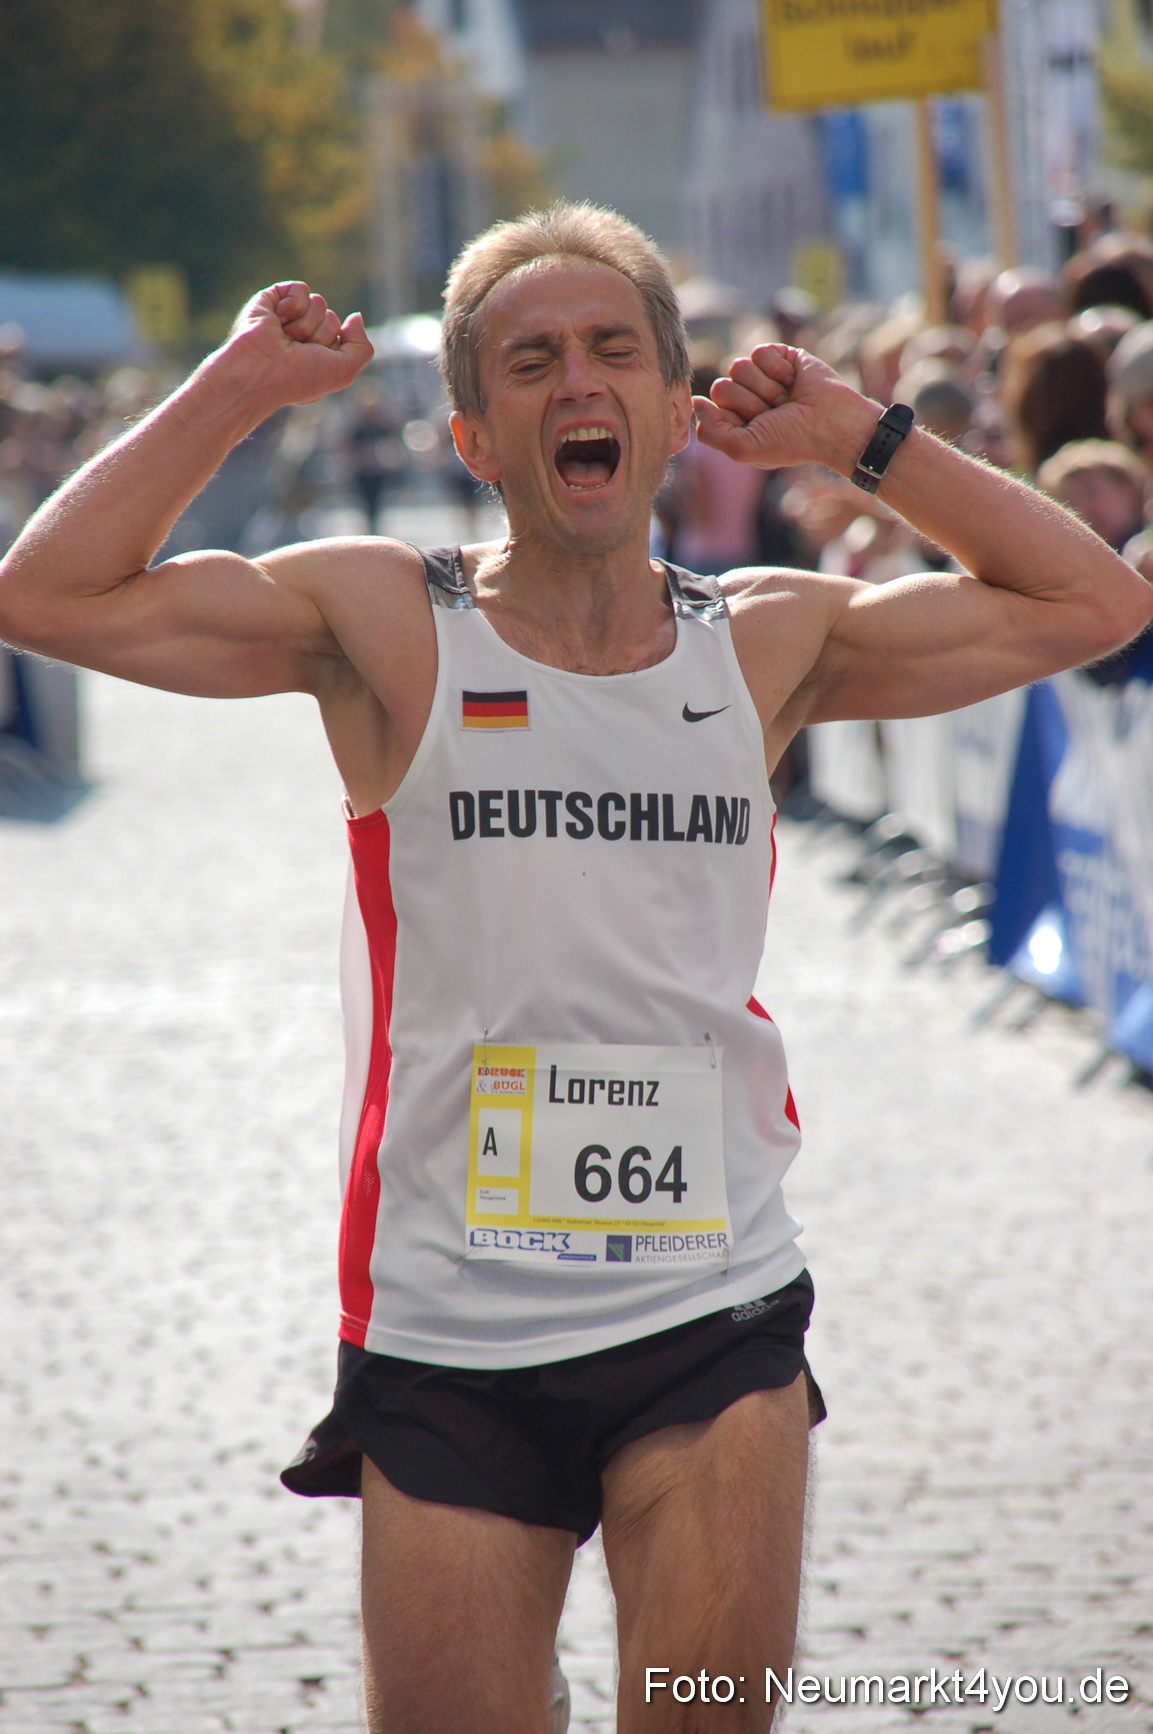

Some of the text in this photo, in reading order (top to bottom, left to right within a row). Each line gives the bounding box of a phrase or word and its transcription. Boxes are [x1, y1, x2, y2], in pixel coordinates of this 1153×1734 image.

[449, 789, 750, 845] DEUTSCHLAND
[548, 1064, 660, 1106] Lorenz
[482, 1127, 498, 1156] A
[574, 1144, 688, 1204] 664
[470, 1228, 572, 1252] BOCK
[635, 1233, 729, 1252] PFLEIDERER
